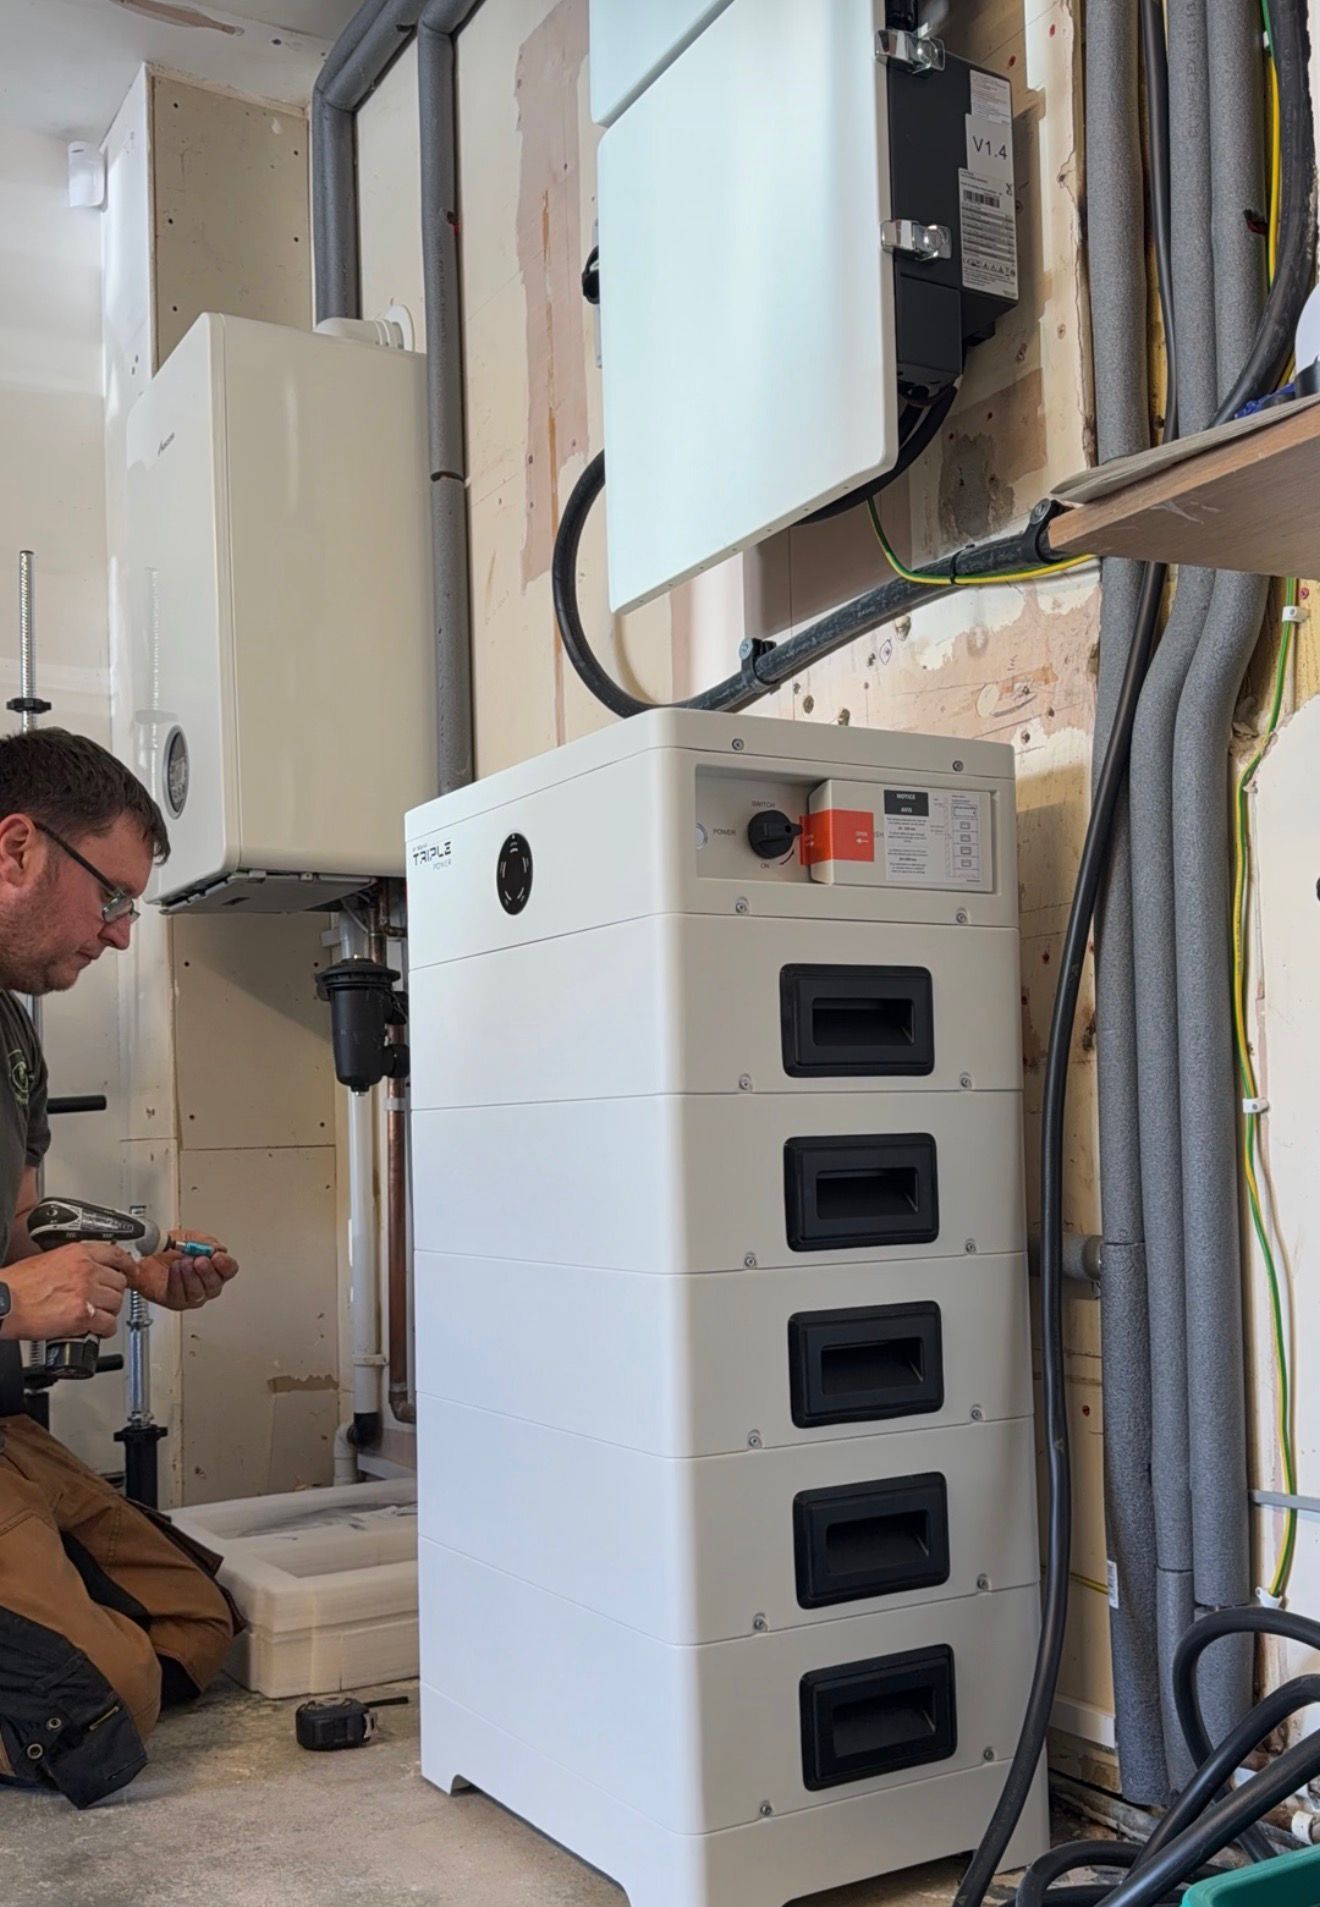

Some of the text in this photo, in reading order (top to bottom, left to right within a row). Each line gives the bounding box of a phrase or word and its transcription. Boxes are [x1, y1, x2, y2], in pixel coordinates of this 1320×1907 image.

[972, 135, 1008, 160] V1.4
[751, 800, 776, 808] SWITCH
[713, 828, 736, 836] POWER
[412, 841, 452, 866] TRIPLE
